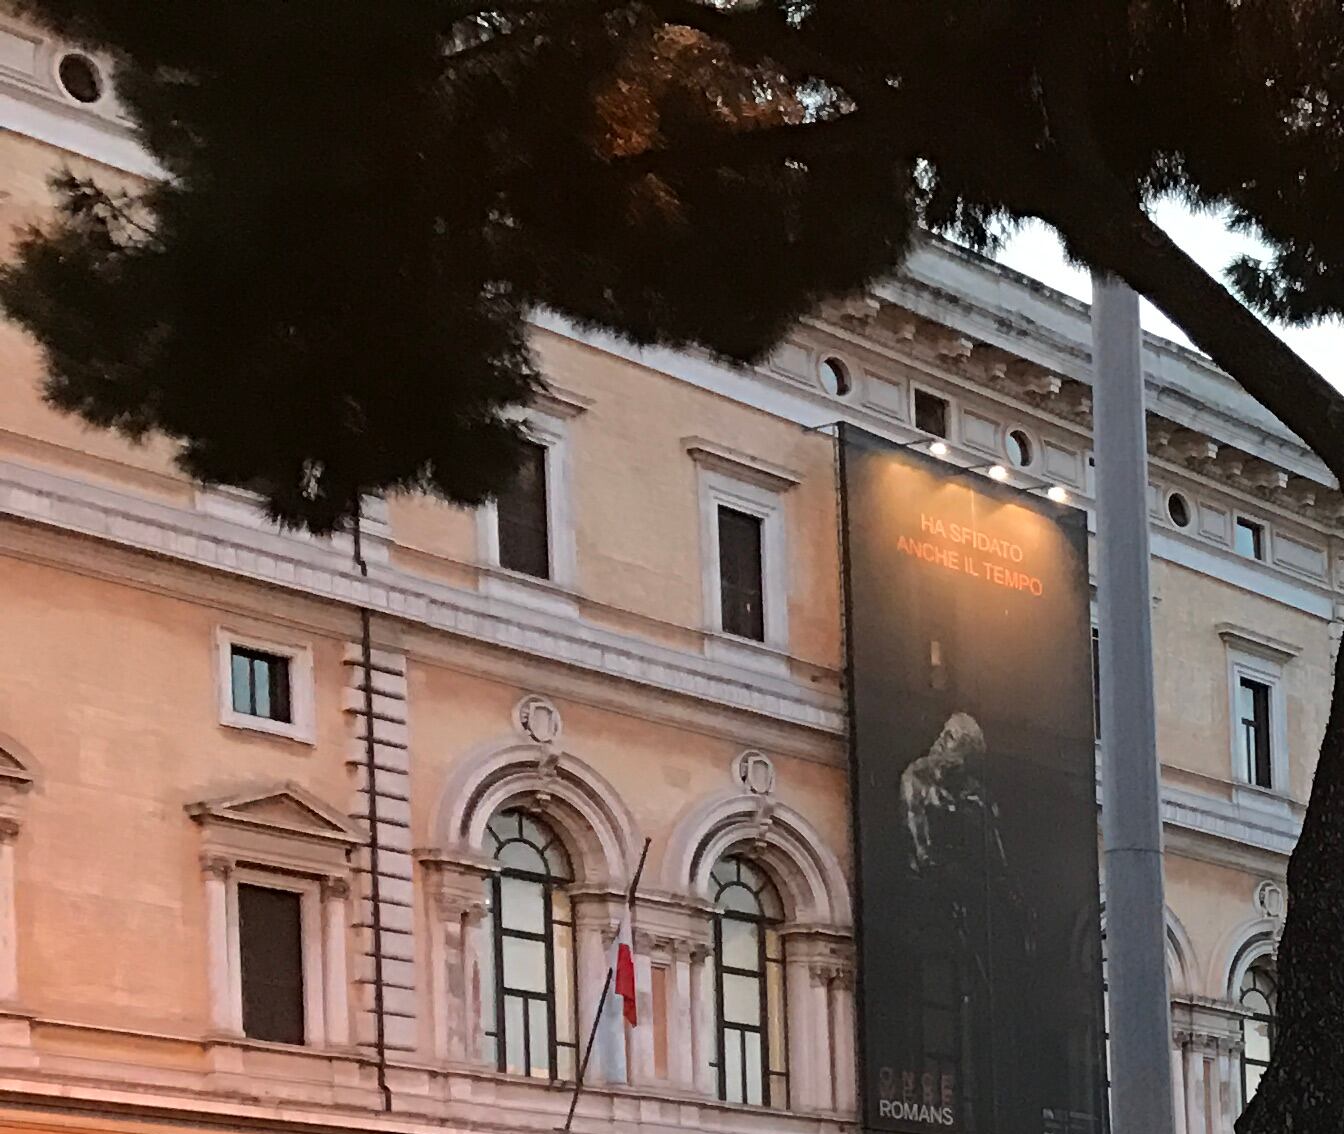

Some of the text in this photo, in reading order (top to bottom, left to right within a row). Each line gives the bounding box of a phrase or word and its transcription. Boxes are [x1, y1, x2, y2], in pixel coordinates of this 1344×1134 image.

[921, 513, 1024, 563] HA SFIDATO
[897, 535, 1043, 597] ANCHE IL TEMPO
[879, 1099, 954, 1126] ROMANS
